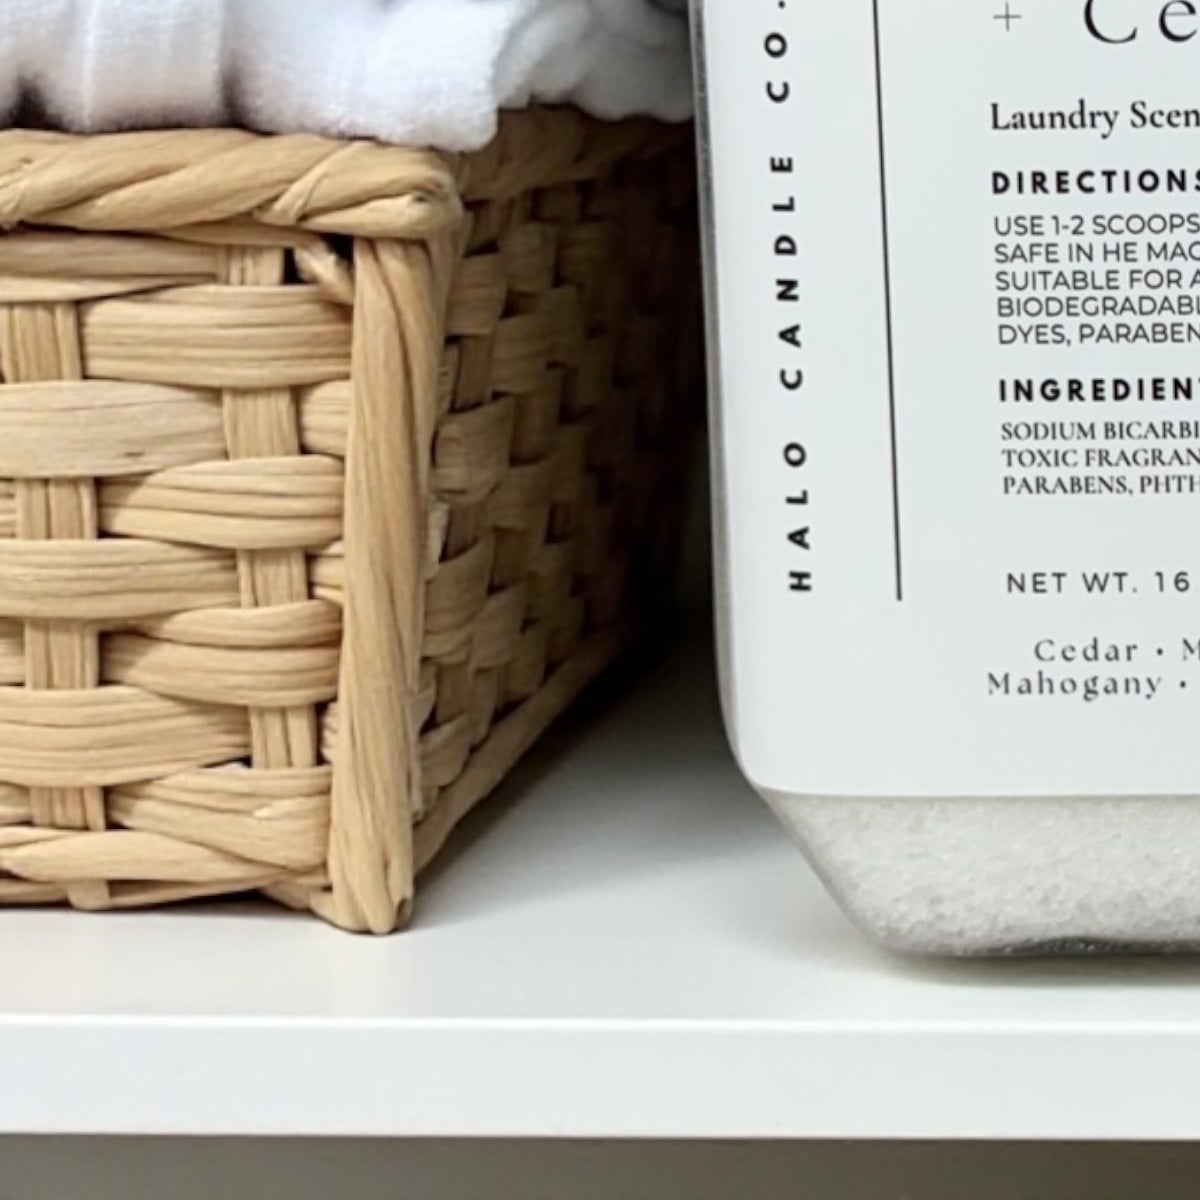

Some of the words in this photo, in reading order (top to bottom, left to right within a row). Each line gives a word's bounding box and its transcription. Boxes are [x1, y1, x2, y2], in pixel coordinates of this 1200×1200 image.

[762, 0, 791, 105] CO.
[990, 97, 1120, 141] Laundry
[993, 214, 1045, 237] USE
[1050, 214, 1086, 236] 1-2
[993, 242, 1060, 265] SAFE
[1067, 242, 1094, 263] IN
[1102, 241, 1138, 263] HE
[768, 156, 804, 392] CANDLE
[994, 269, 1121, 292] SUITABLE
[1128, 268, 1183, 290] FOR
[997, 323, 1072, 347] DYES,
[1001, 421, 1096, 441] SODIUM
[1000, 448, 1079, 468] TOXIC
[1003, 475, 1134, 496] PARABENS,
[782, 441, 813, 593] HALO
[1006, 571, 1068, 595] NET
[1081, 571, 1138, 594] WT.
[1154, 570, 1191, 593] 16
[1033, 636, 1138, 663] Cedar
[987, 669, 1162, 703] Mahogany
